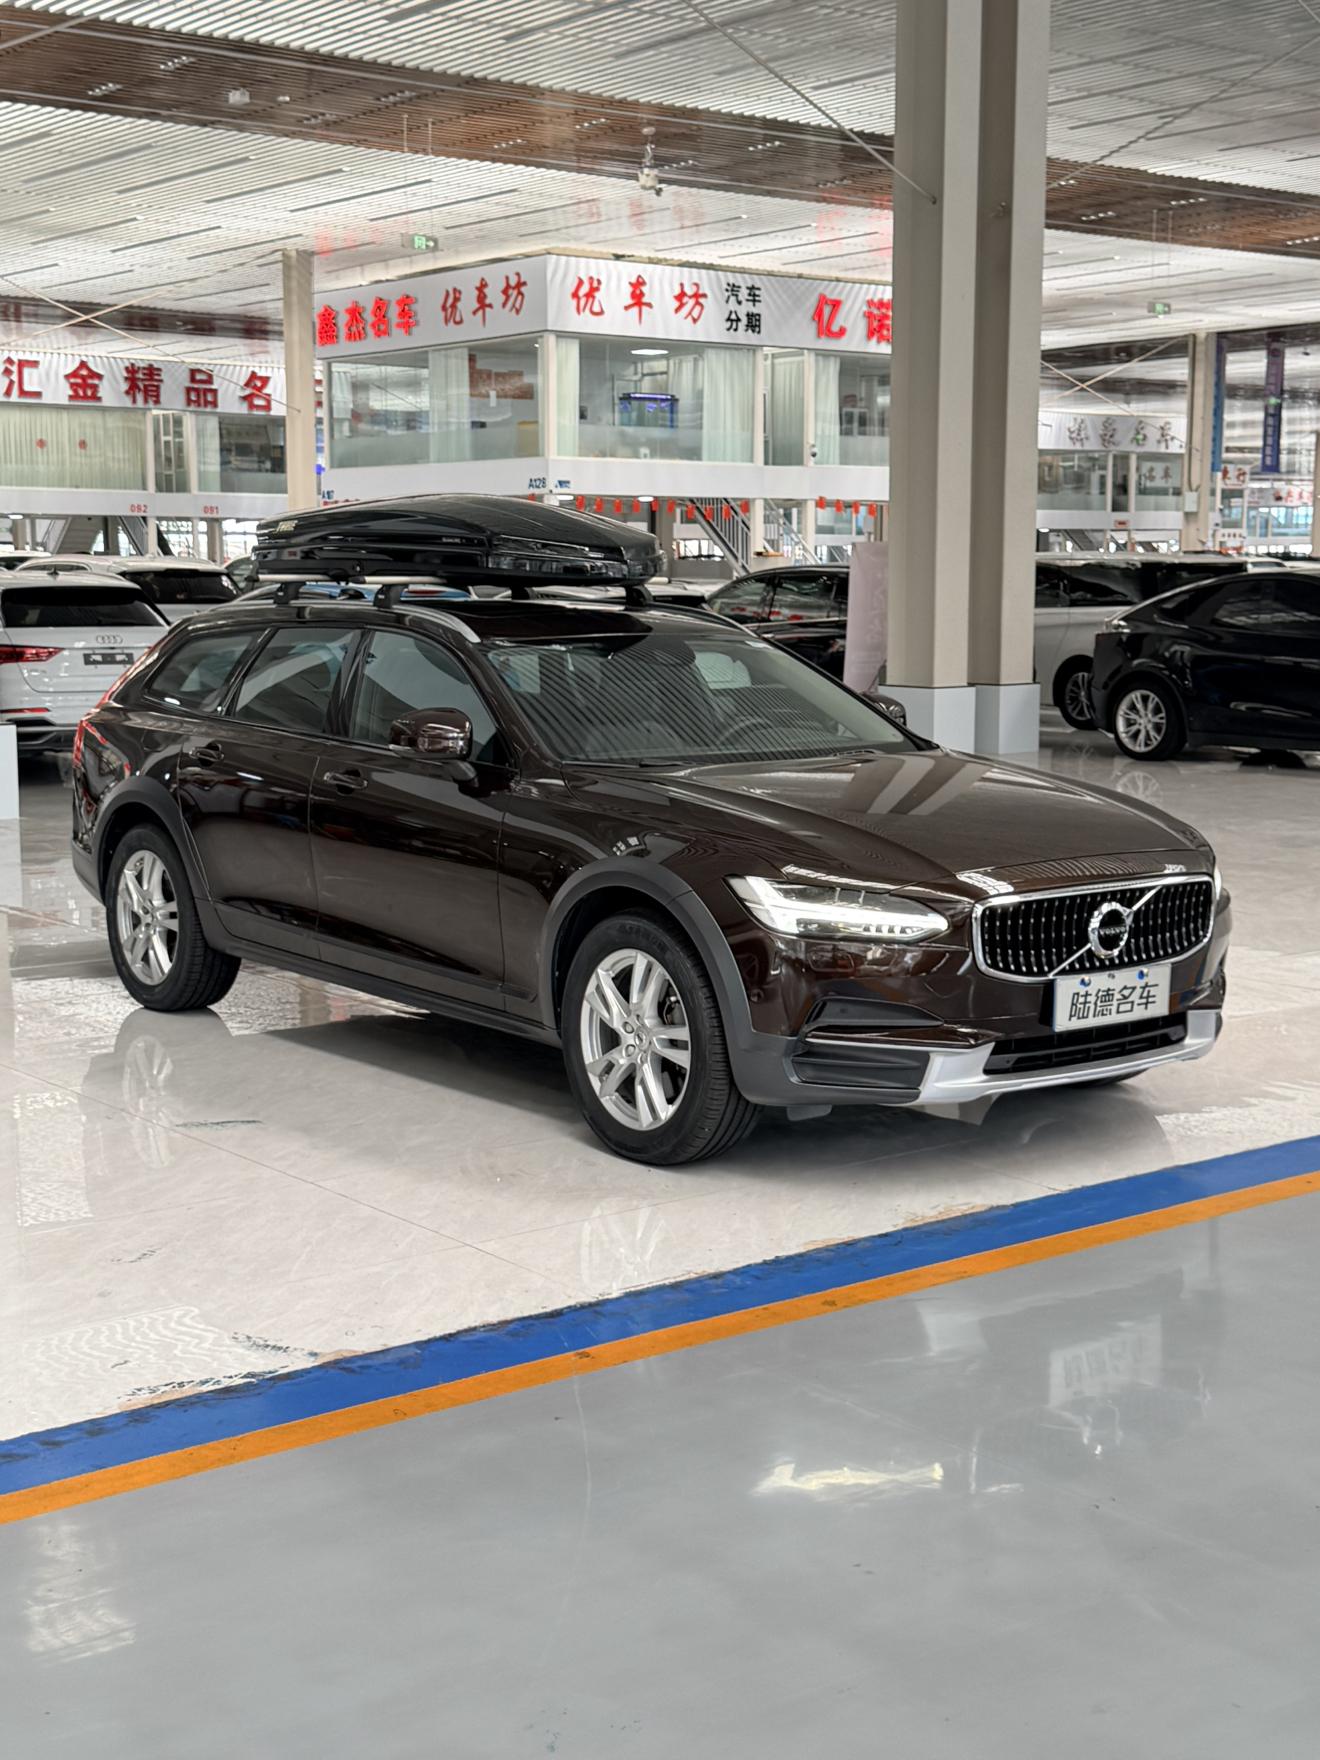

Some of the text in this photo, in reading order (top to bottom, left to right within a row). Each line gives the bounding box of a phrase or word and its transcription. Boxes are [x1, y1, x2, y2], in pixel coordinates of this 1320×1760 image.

[441, 272, 528, 328] 优车坊
[571, 274, 709, 325] 优车坊
[725, 282, 762, 307] 汽车
[316, 295, 417, 347] 鑫杰名车
[725, 310, 762, 334] 分期
[2, 355, 273, 412] 汇金精品名
[130, 504, 149, 514] 092
[203, 505, 220, 515] 091
[1068, 982, 1159, 1022] 陆德名车
